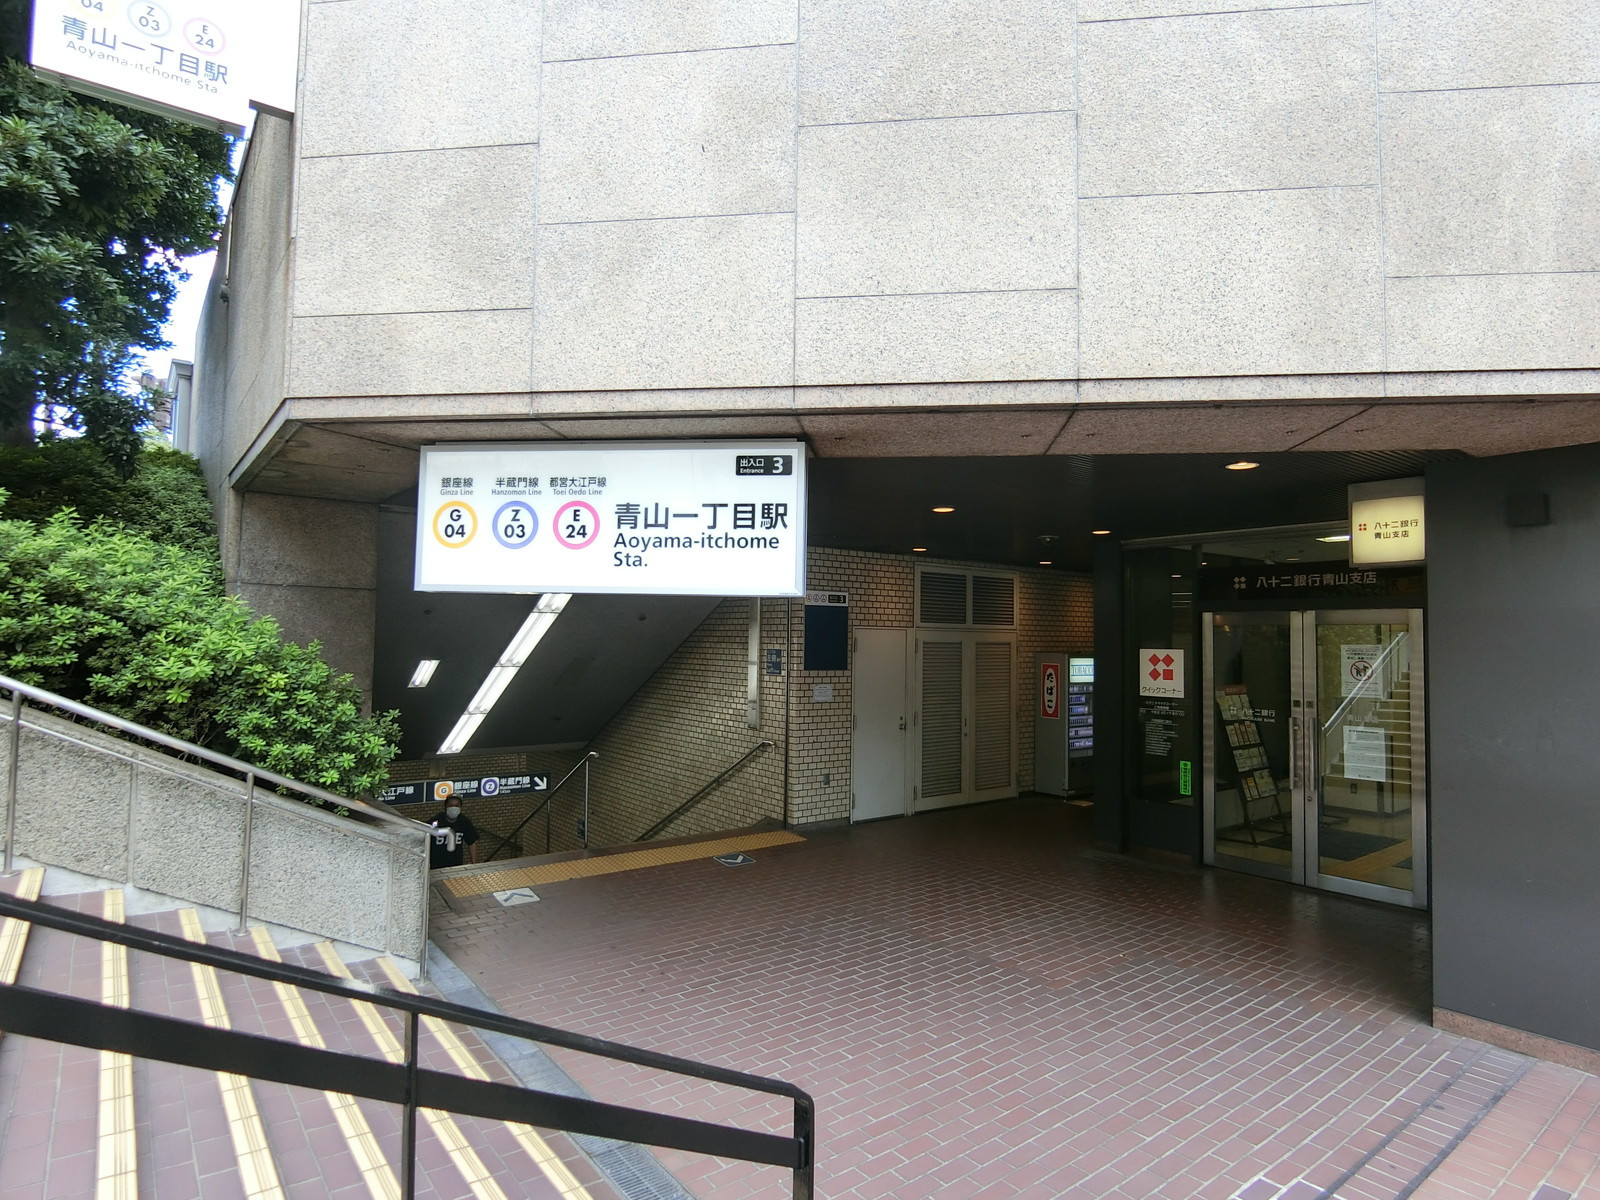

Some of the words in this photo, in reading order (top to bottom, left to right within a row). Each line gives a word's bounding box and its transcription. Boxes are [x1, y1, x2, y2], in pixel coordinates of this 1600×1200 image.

[81, 0, 104, 12] 04
[146, 6, 155, 17] Z
[138, 16, 160, 31] 03
[202, 24, 208, 35] E
[195, 34, 215, 49] 24
[61, 15, 228, 84] 青山一丁目駅
[740, 458, 764, 467] 出入口
[772, 457, 784, 473] 3
[441, 477, 473, 488] 銀座線
[495, 477, 539, 488] 半蔵門線
[550, 476, 607, 488] 都営大江戸線
[450, 509, 462, 522] G
[511, 509, 520, 522] Z
[573, 509, 580, 522] E
[615, 502, 788, 530] 青山一丁目駅
[1374, 518, 1419, 529] 八十二銀行
[444, 524, 466, 538] 04
[504, 525, 526, 538] 03
[565, 525, 587, 538] 24
[1374, 530, 1409, 539] 青山支店
[613, 532, 780, 552] Aoyama-itchome
[613, 551, 648, 567] Sta.
[1256, 571, 1377, 589] 八十二銀行青山支店
[839, 595, 844, 603] 3
[1046, 672, 1055, 709] たばこ
[1141, 686, 1182, 694] クイックコーナー
